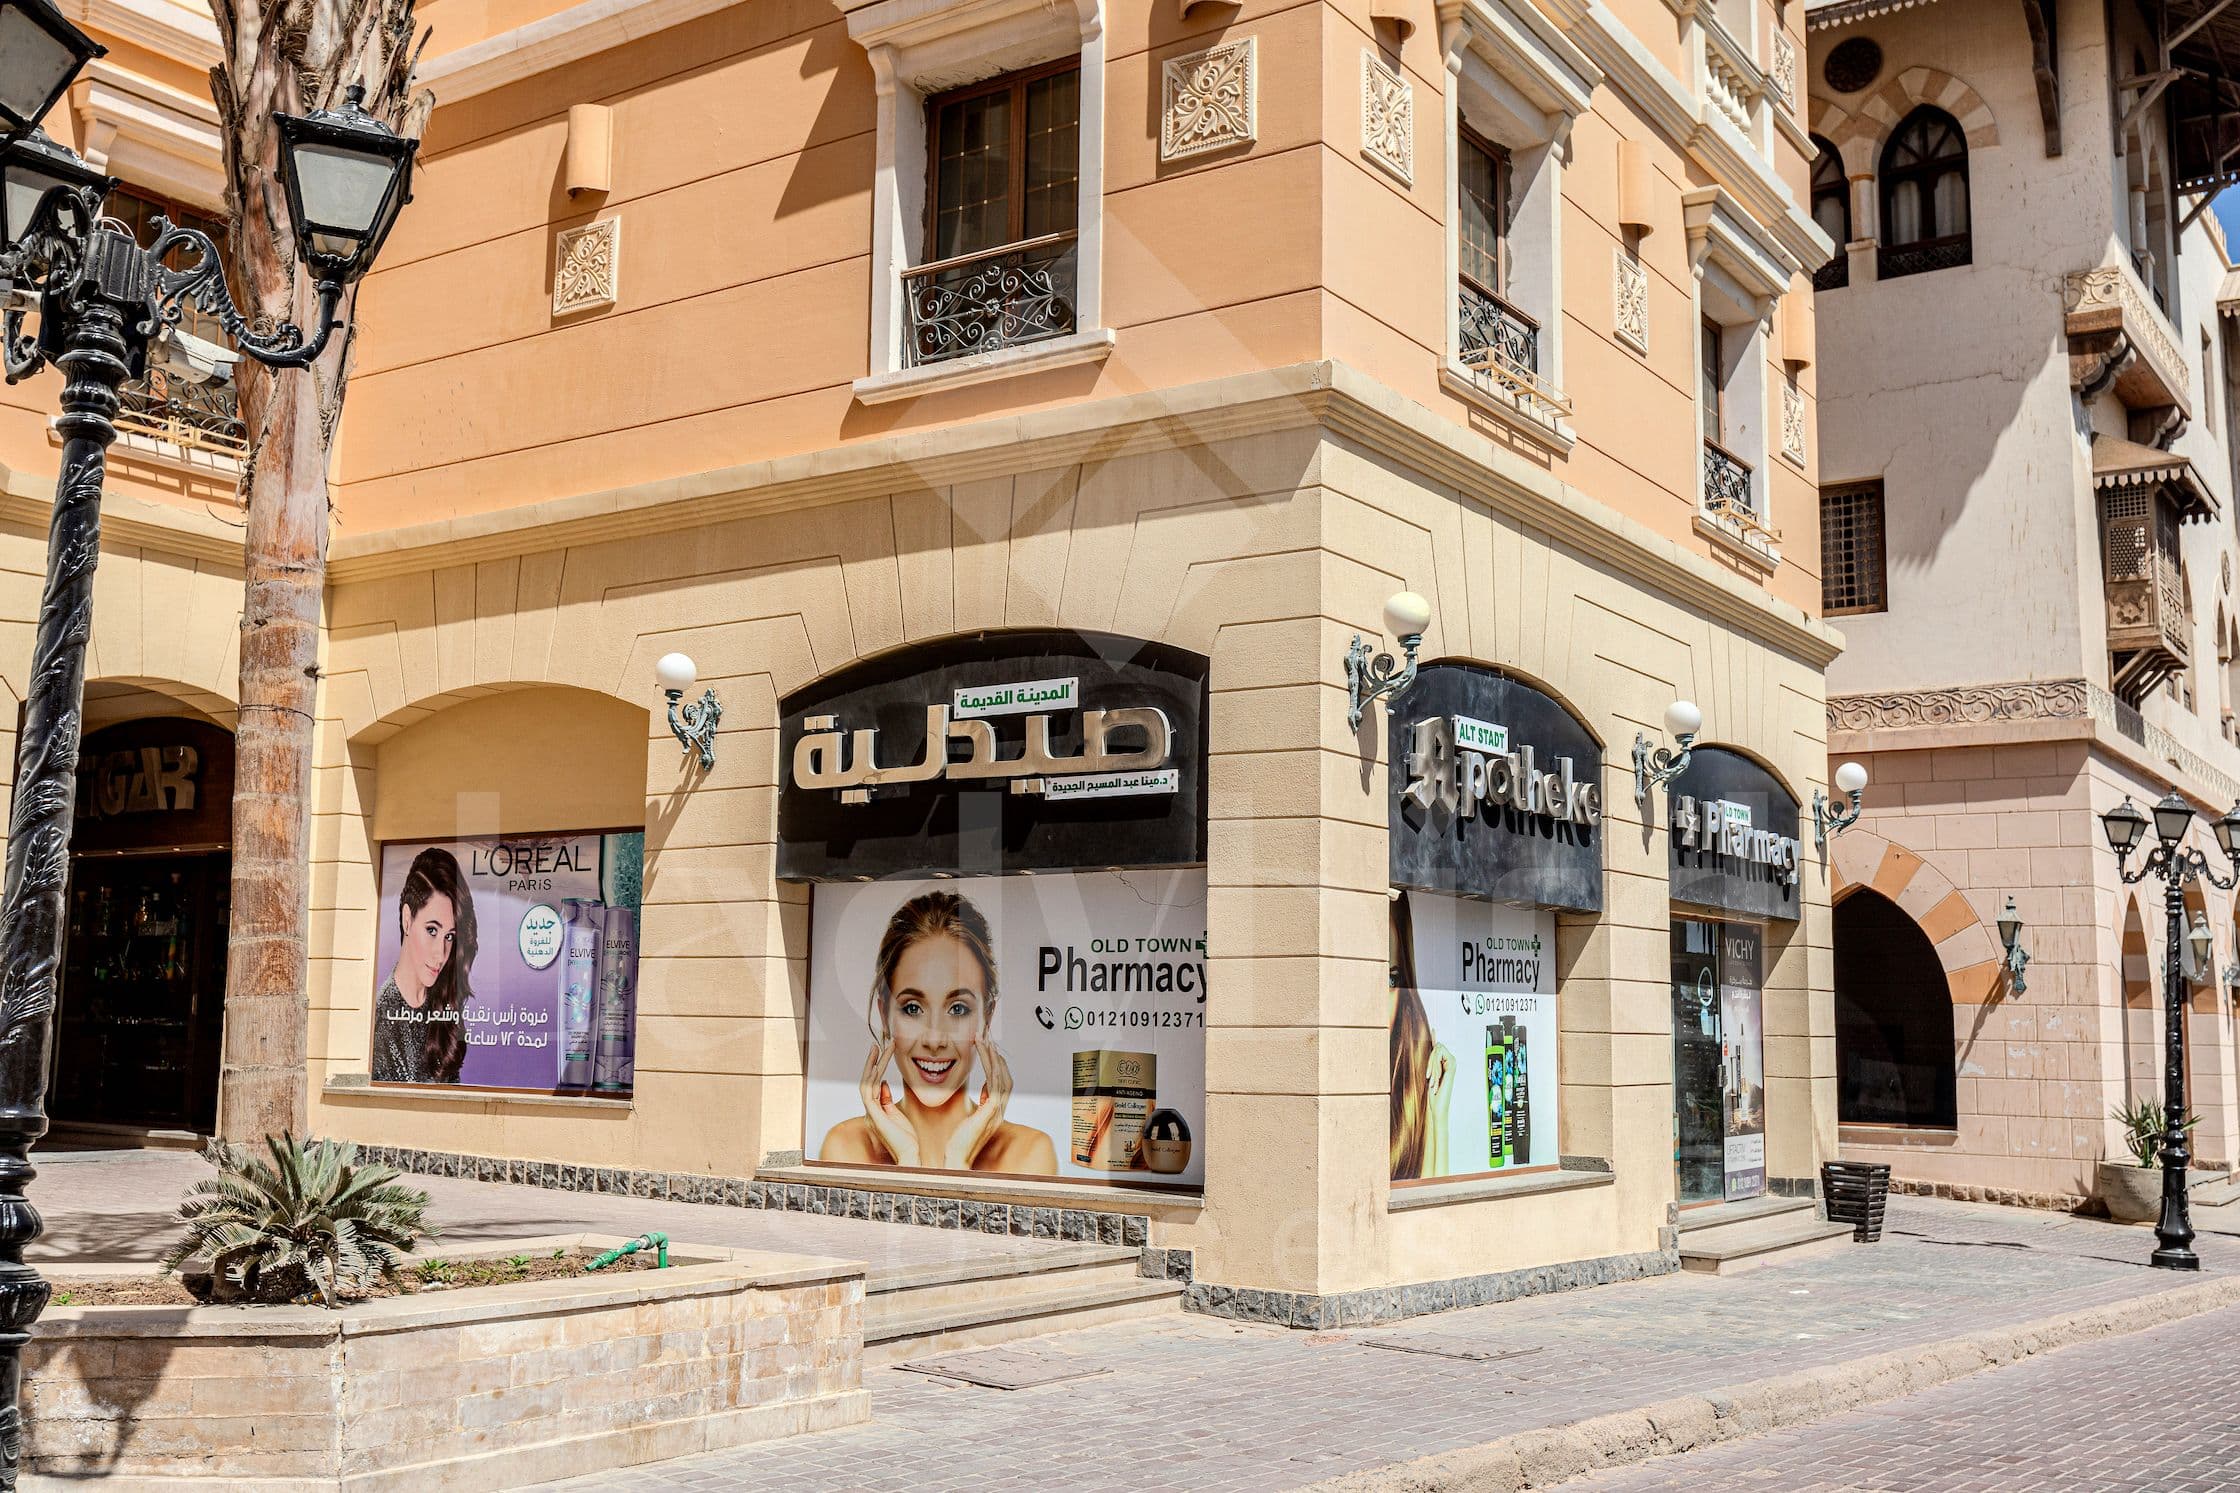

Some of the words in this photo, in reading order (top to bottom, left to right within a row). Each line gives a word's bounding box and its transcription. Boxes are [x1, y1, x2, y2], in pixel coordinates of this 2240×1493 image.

[960, 690, 1013, 711] القديمة
[1017, 684, 1069, 704] المدينة
[1459, 723, 1477, 742] ALT
[1478, 727, 1505, 749] STADT
[794, 704, 1171, 804] صيدلية
[1400, 716, 1602, 827] Apotheke
[1052, 779, 1085, 793] الجديدة
[1087, 777, 1122, 793] المسيح
[1123, 776, 1140, 788] عبد
[1702, 800, 1800, 885] Pharmacy
[472, 843, 591, 877] L'ORÉAL
[526, 917, 556, 935] جديد
[570, 948, 596, 959] ELVIVE
[607, 940, 630, 950] ELVIVE
[1091, 938, 1129, 953] OLD
[1135, 938, 1191, 953] TOWN
[1486, 937, 1504, 950] OLD
[1506, 938, 1530, 951] TOWN
[1725, 936, 1754, 960] VICHY
[1038, 946, 1207, 1003] Pharmacy
[1462, 941, 1540, 992] Pharmacy
[386, 1005, 424, 1025] مرطب
[426, 1003, 460, 1025] وشعر
[493, 1003, 517, 1026] رأس
[1486, 998, 1537, 1012] 01210912371
[462, 1006, 491, 1027] نقية
[520, 1008, 548, 1027] فروة
[1087, 1011, 1203, 1028] 01210912371
[464, 1029, 498, 1046] ساعة
[517, 1031, 548, 1049] لمدة
